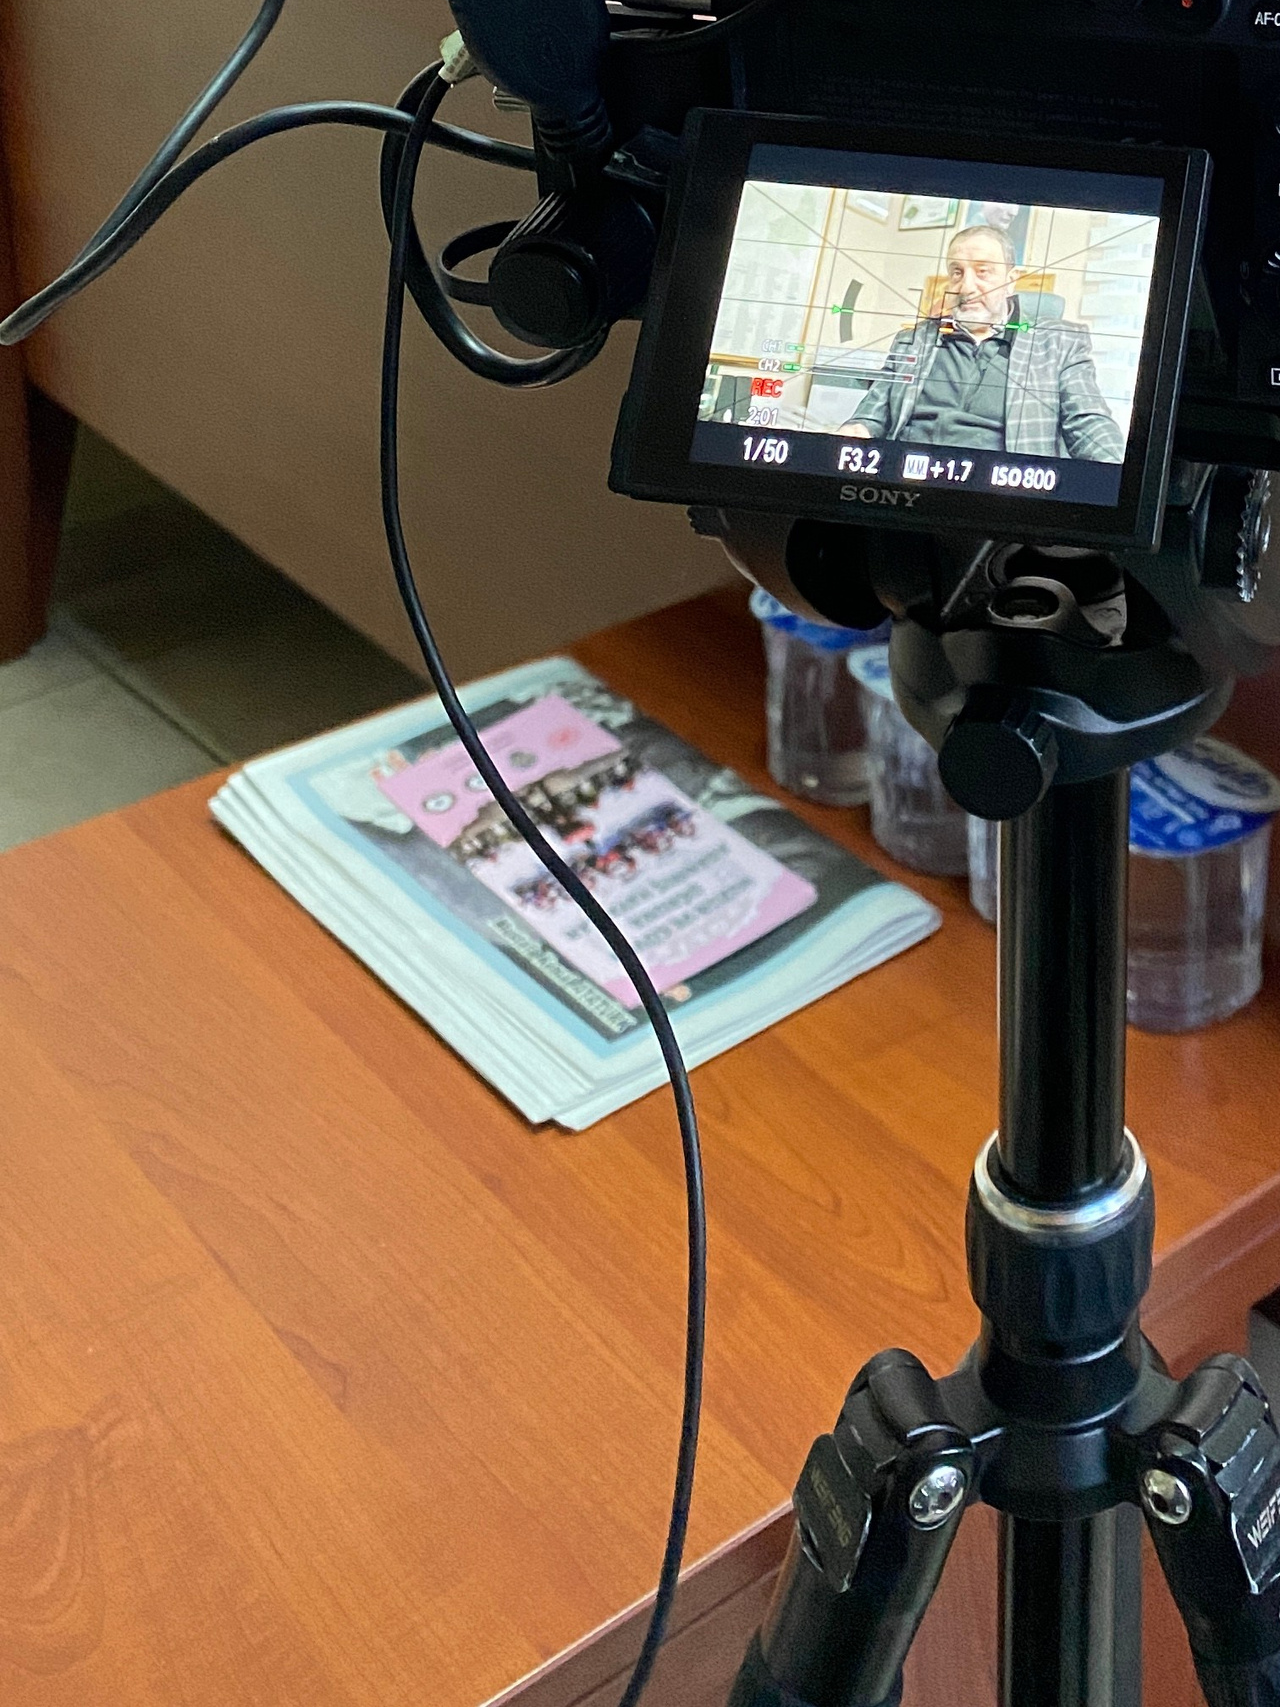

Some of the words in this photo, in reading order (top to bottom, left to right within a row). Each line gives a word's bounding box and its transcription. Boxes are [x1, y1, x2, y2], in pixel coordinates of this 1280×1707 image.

[758, 358, 781, 372] CH2
[750, 378, 783, 398] REC
[746, 406, 778, 426] 2:01
[743, 437, 789, 465] 1/50
[838, 446, 881, 475] F3.2
[840, 485, 920, 507] SONY
